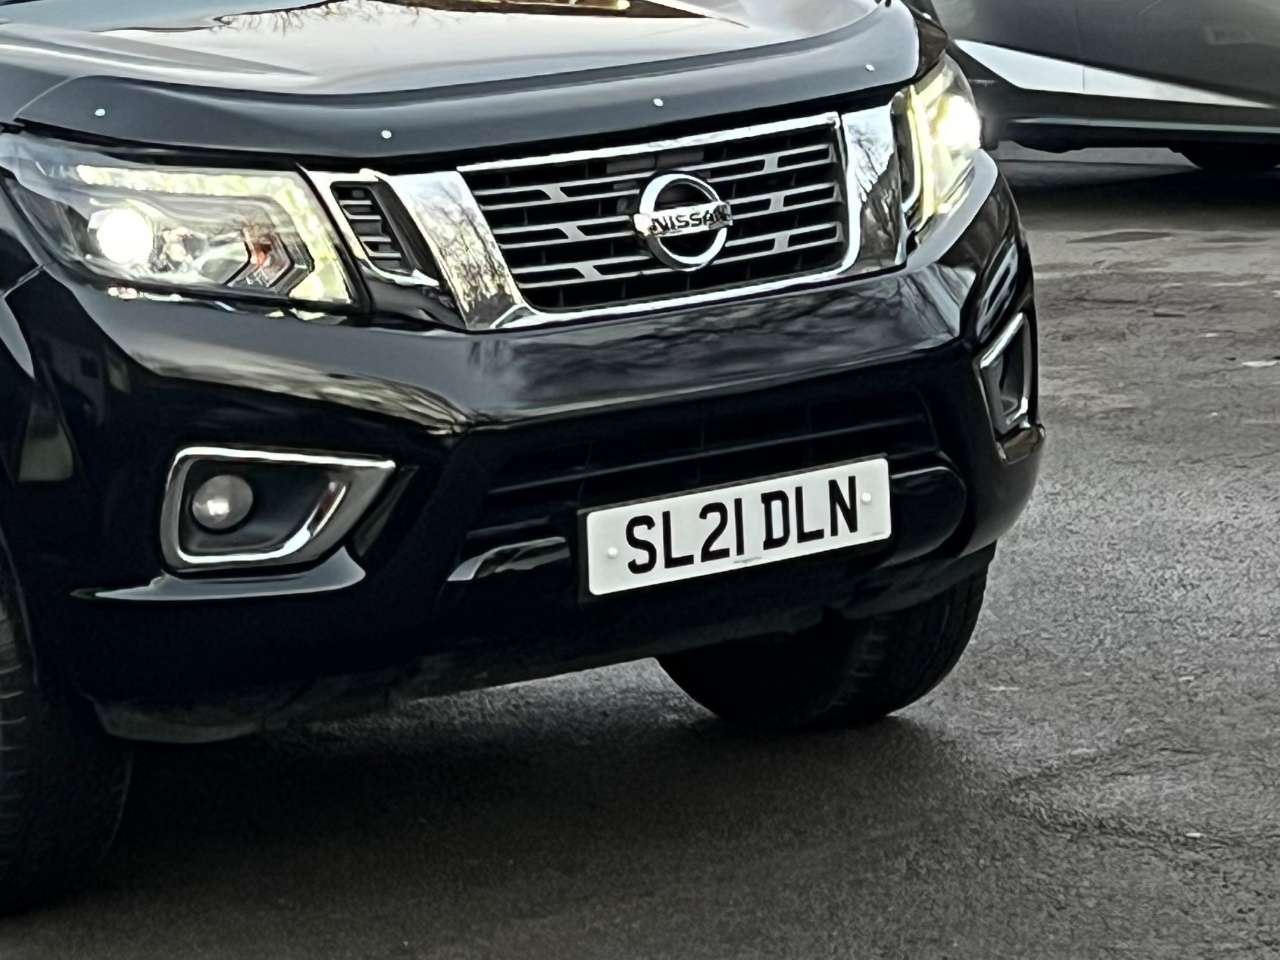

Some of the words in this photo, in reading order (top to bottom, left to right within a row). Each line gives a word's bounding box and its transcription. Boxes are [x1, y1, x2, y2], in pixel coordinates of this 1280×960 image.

[650, 206, 728, 232] NISSAN
[625, 498, 745, 575] SL21
[760, 475, 859, 551] DLN
